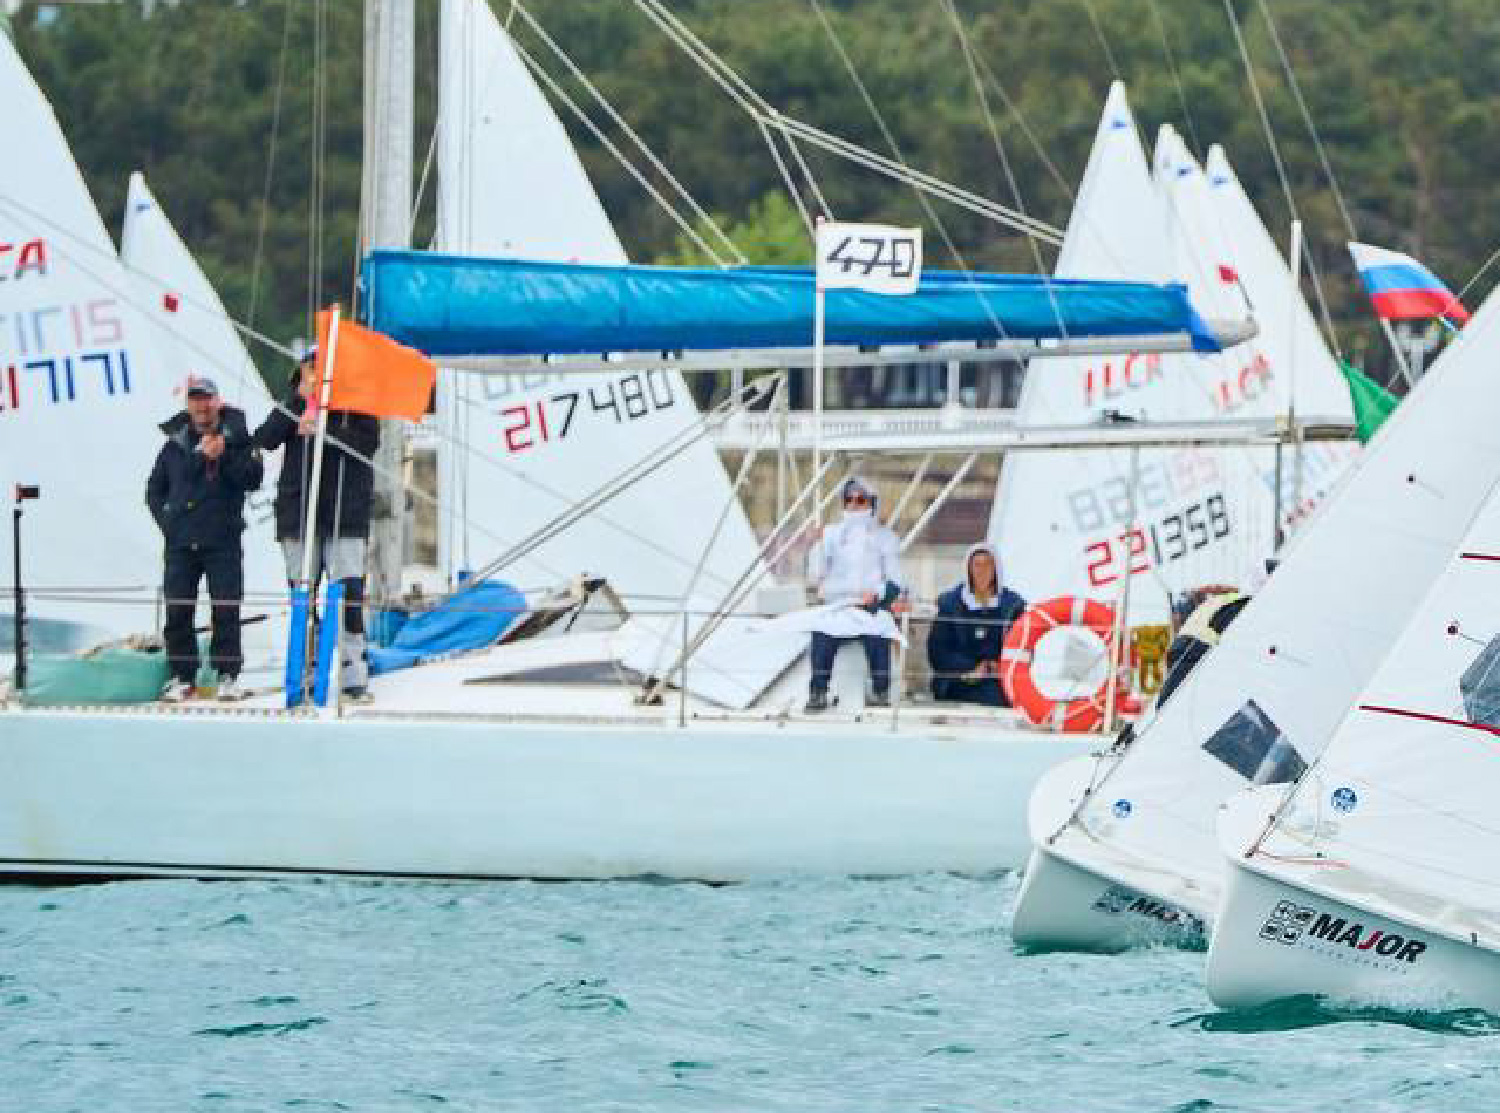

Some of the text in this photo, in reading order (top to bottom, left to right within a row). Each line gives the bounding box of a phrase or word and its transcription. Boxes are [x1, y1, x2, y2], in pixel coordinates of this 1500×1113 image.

[827, 236, 915, 277] 470
[0, 349, 132, 409] 17171
[500, 366, 675, 452] 217480
[1085, 490, 1230, 587] 221358
[1308, 912, 1427, 963] MAJOR
